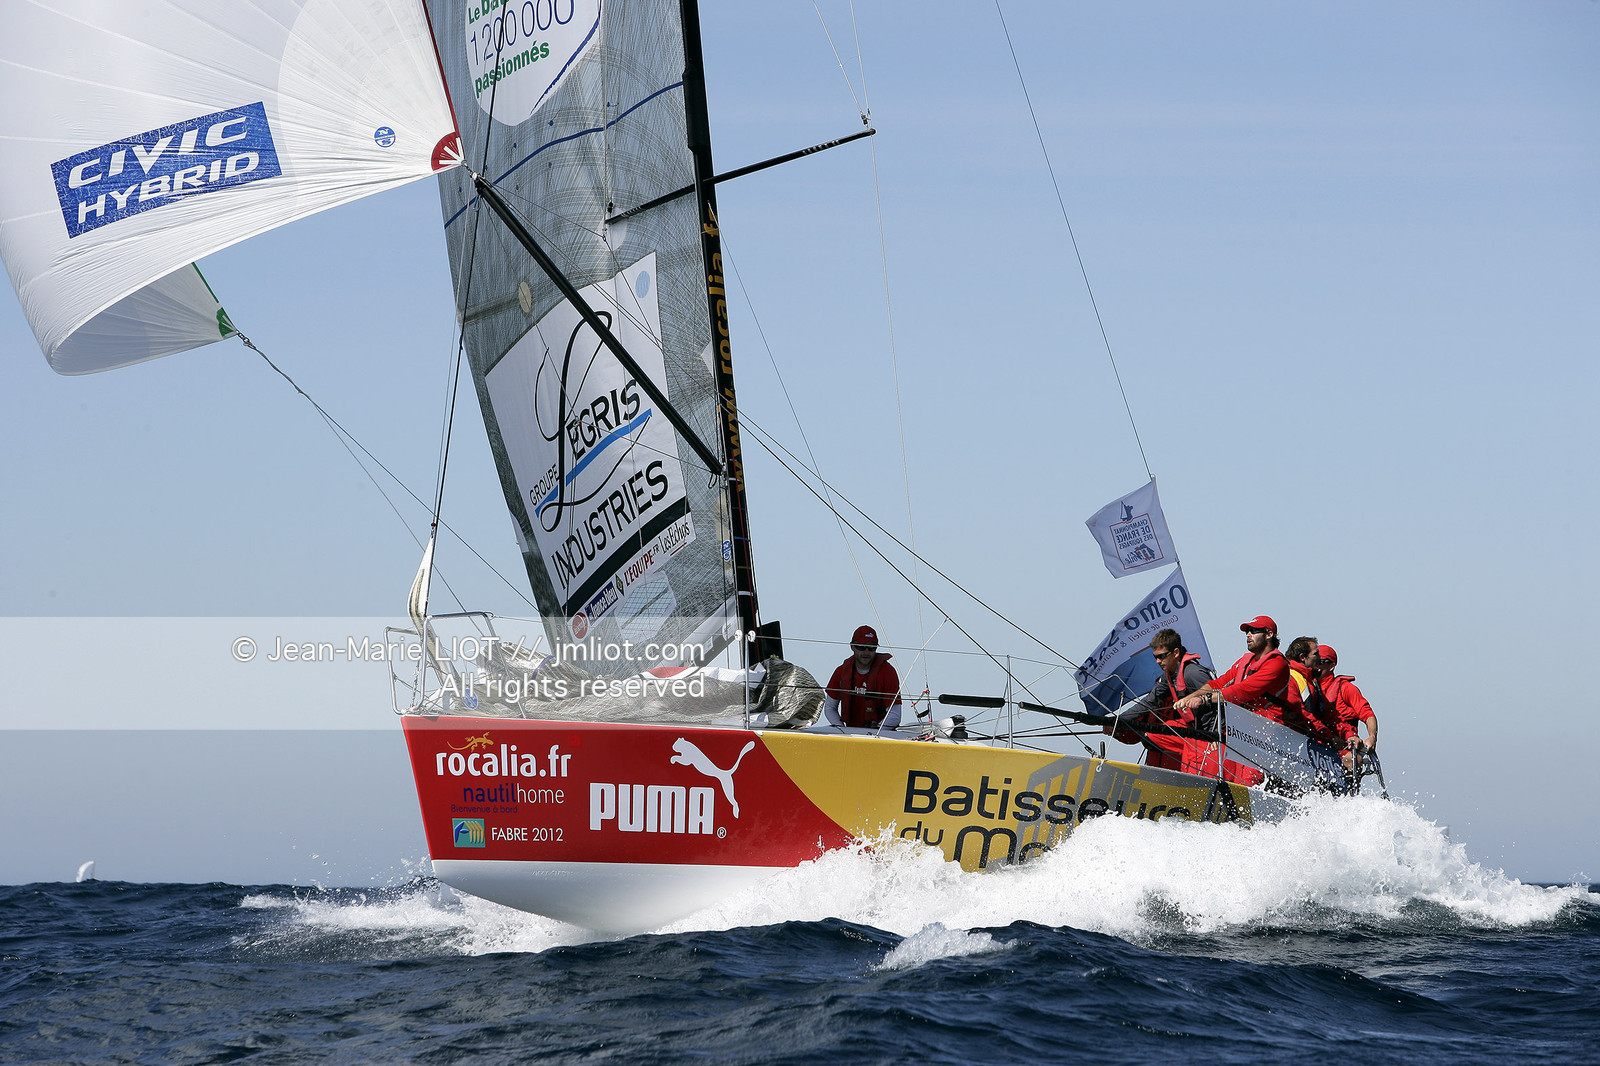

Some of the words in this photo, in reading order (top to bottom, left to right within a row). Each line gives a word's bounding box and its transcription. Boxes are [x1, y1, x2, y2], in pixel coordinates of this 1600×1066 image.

[468, 7, 480, 25] Le
[475, 40, 550, 99] passionnés
[68, 116, 247, 189] CIVIC
[77, 151, 260, 224] HYBRID
[529, 464, 560, 507] GROUPE
[551, 460, 670, 590] INDUSTRIES
[436, 743, 572, 777] rocalia.fr
[451, 804, 491, 813] Bienvenue
[492, 804, 499, 813] à
[500, 805, 518, 814] bord
[463, 782, 565, 804] nautilhome
[590, 782, 715, 834] PUMA
[491, 827, 529, 841] FABRE
[532, 827, 564, 842] 2012
